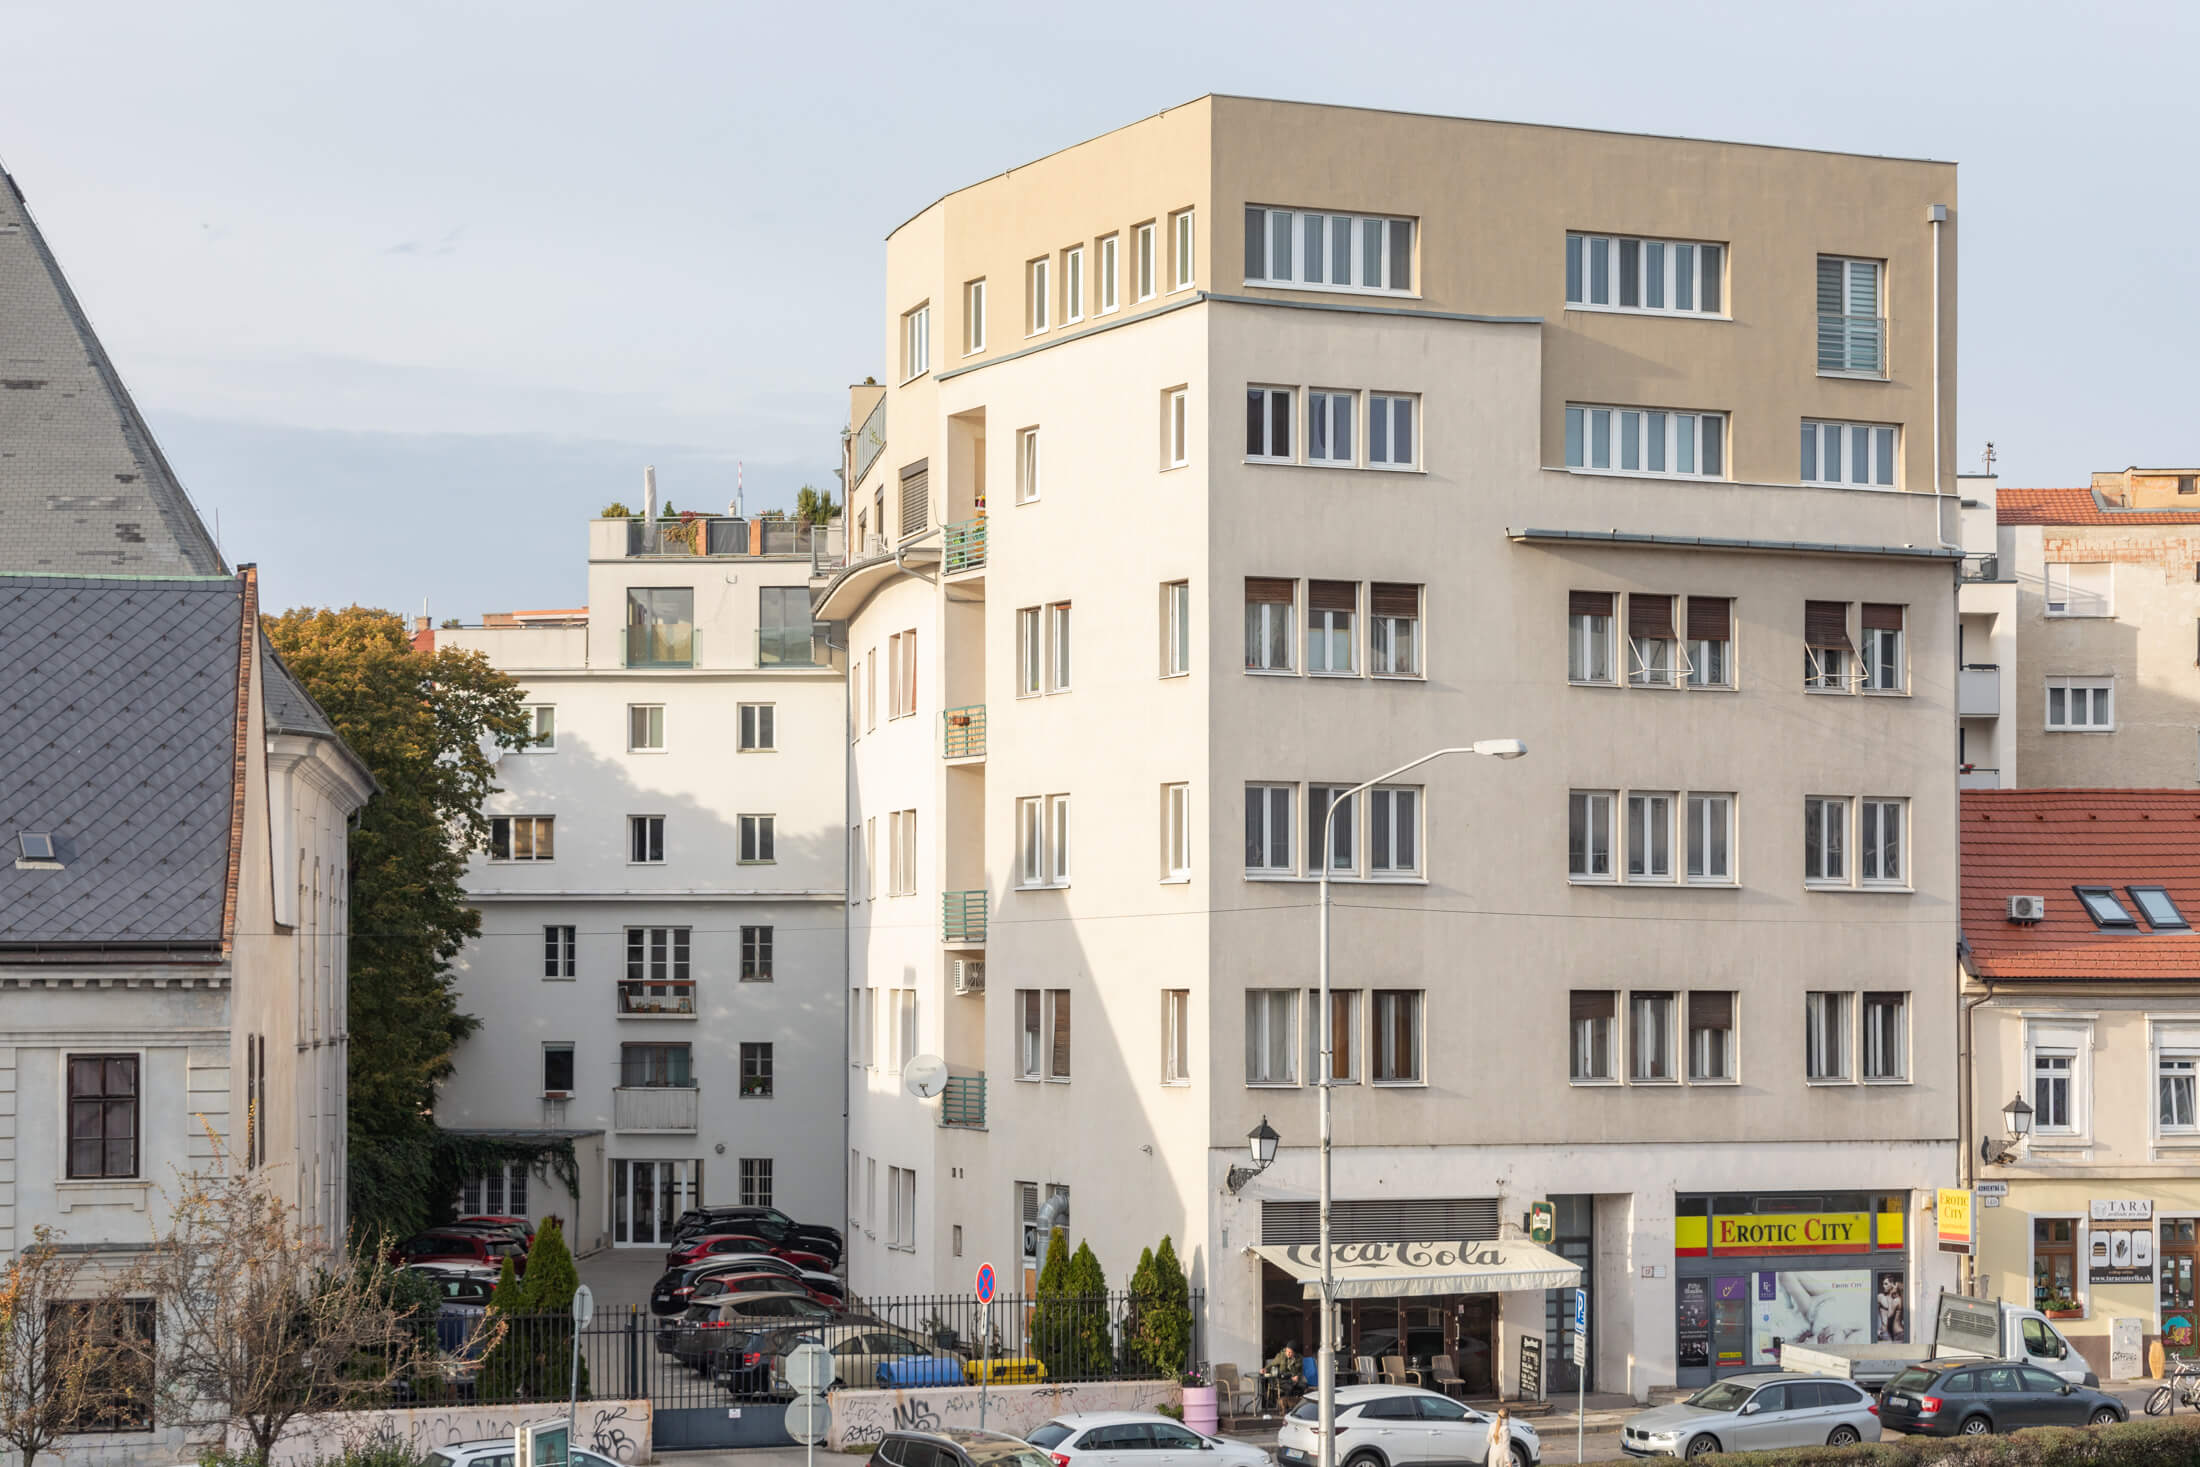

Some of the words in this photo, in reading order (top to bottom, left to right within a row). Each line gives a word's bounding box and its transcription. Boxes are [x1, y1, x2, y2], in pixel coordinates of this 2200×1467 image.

[2108, 1201, 2148, 1211] TARA
[1720, 1220, 1797, 1243] EROTIC
[1804, 1218, 1853, 1241] CITY
